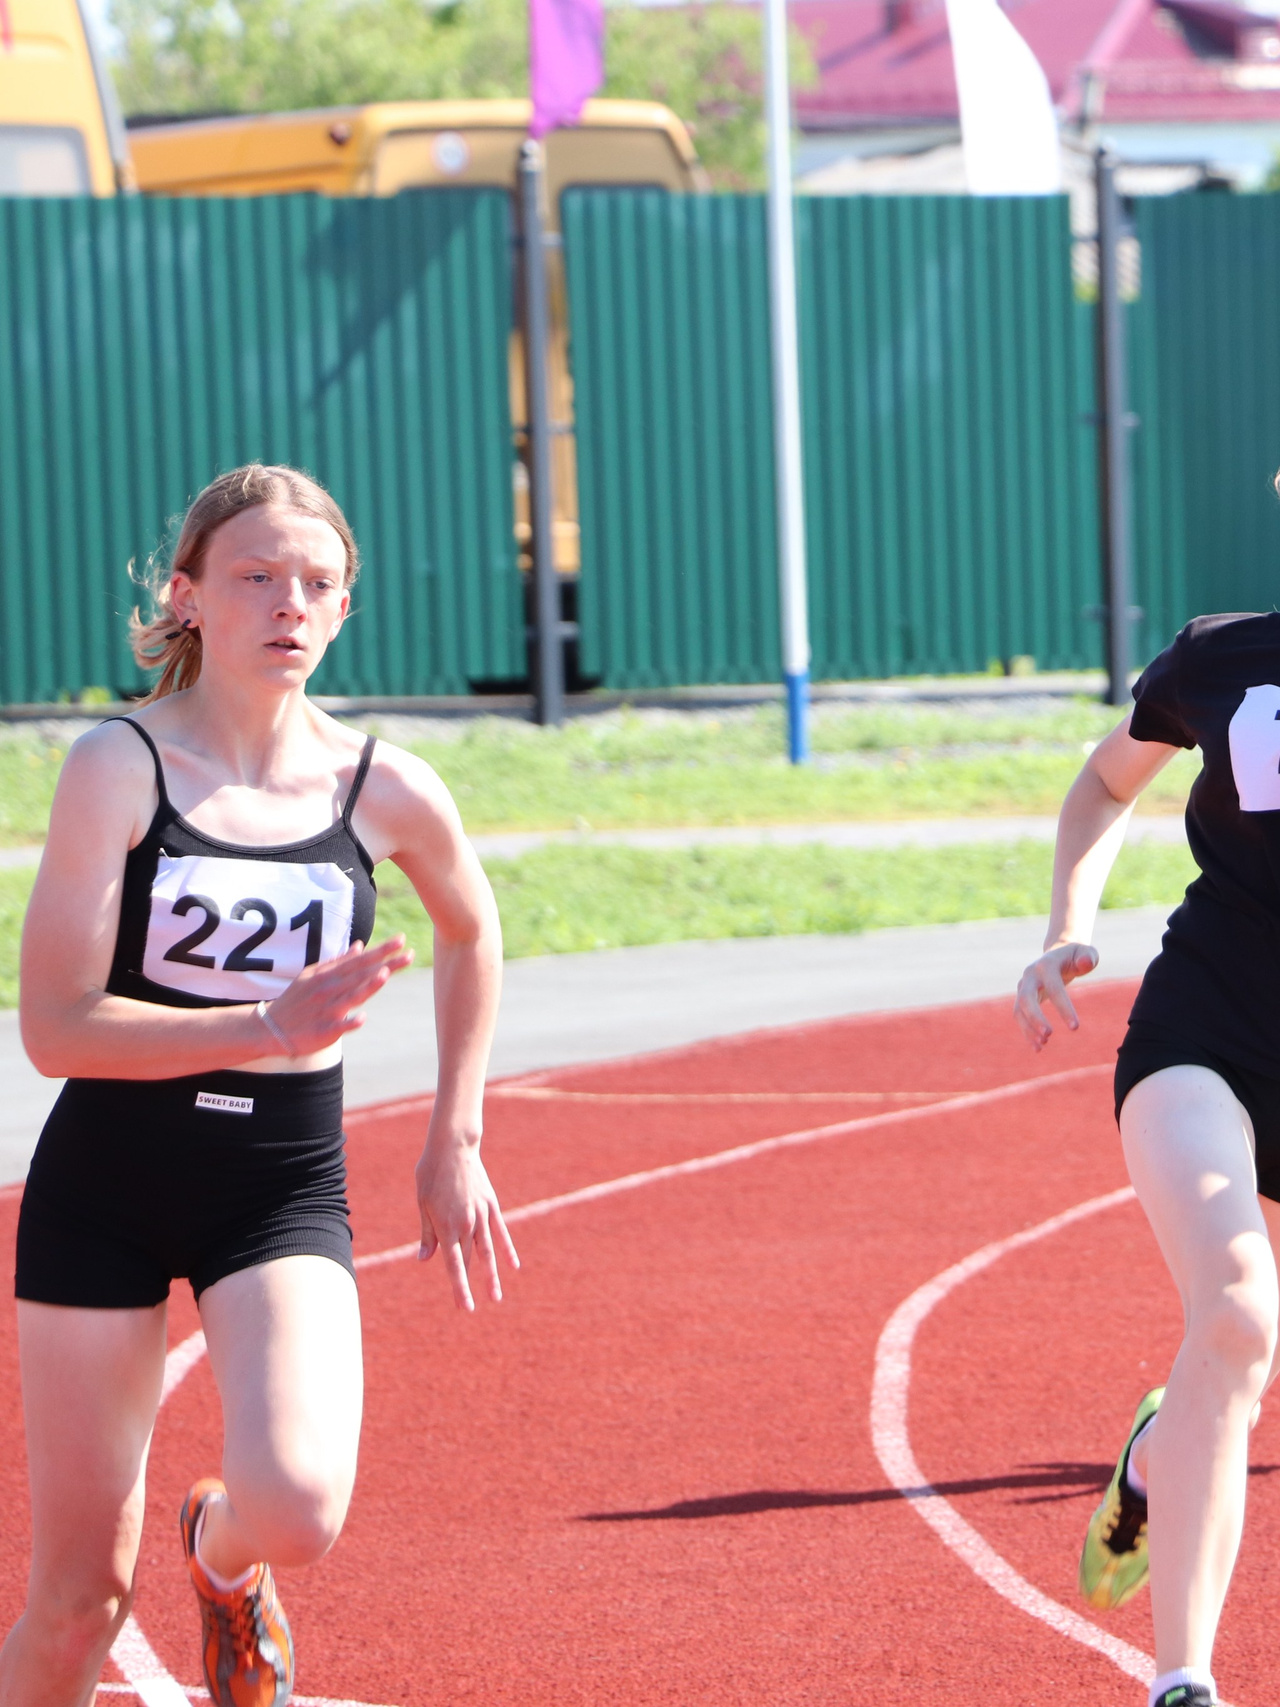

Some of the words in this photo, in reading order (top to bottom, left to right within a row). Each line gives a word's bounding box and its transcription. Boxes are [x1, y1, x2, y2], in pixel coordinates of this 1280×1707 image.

[163, 893, 324, 972] 221
[198, 1095, 227, 1106] SWEET
[228, 1100, 252, 1109] BABY
